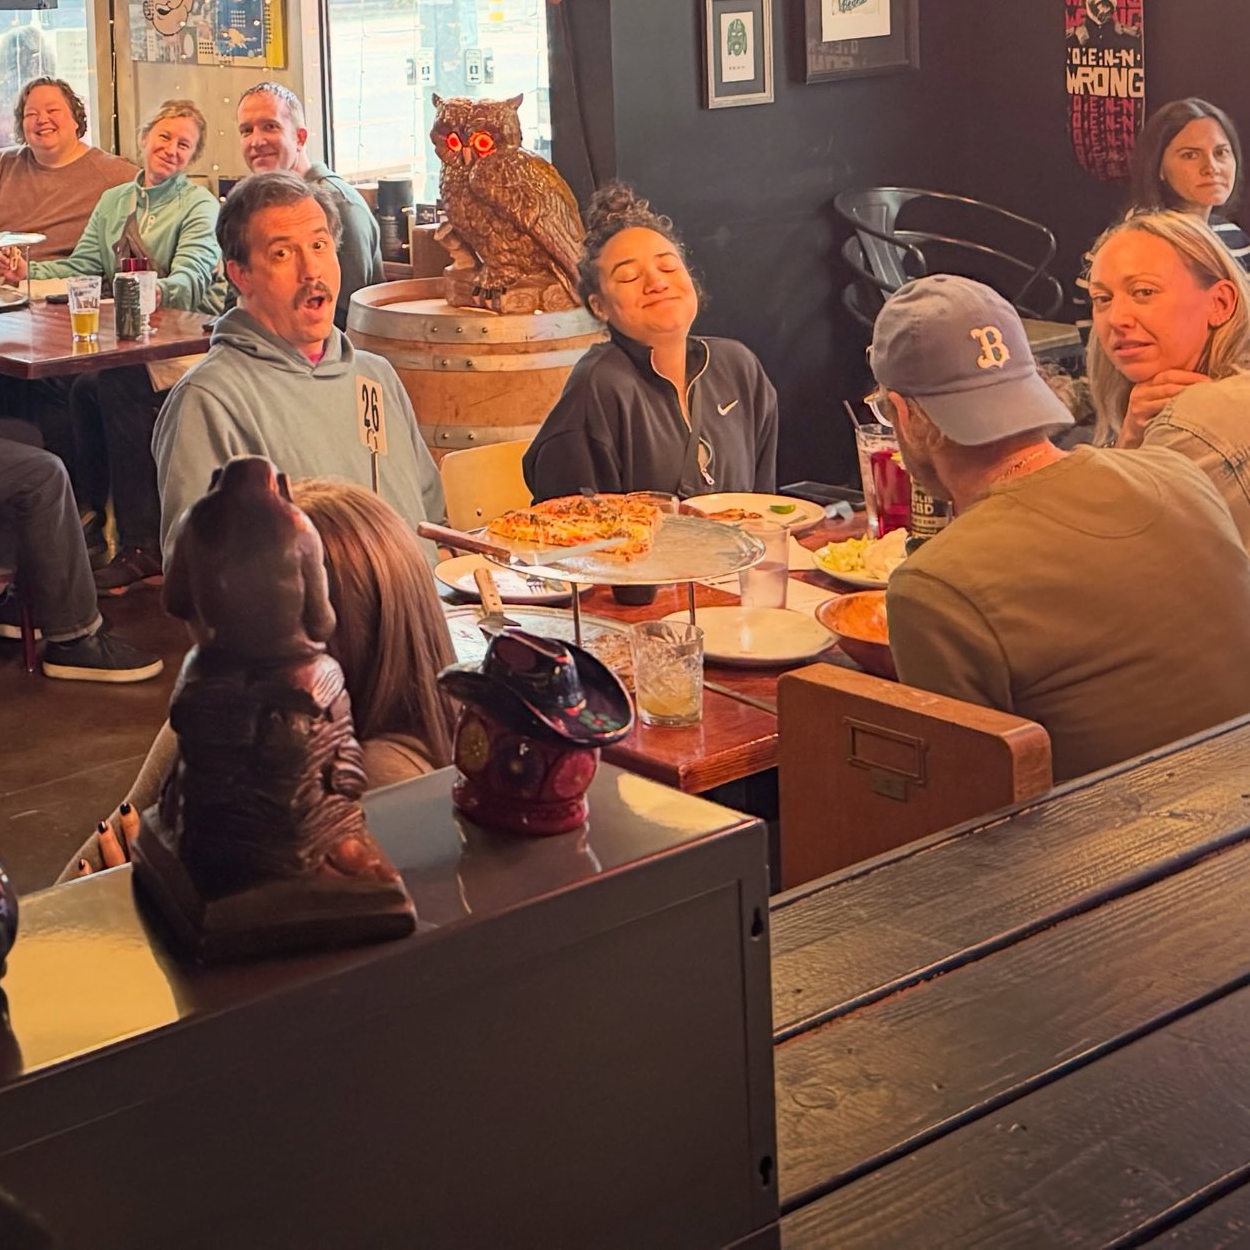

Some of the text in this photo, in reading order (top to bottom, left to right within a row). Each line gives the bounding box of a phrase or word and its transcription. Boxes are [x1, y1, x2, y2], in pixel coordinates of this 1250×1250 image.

[1066, 66, 1144, 98] WRONG
[970, 325, 1011, 369] B
[362, 383, 379, 431] 26
